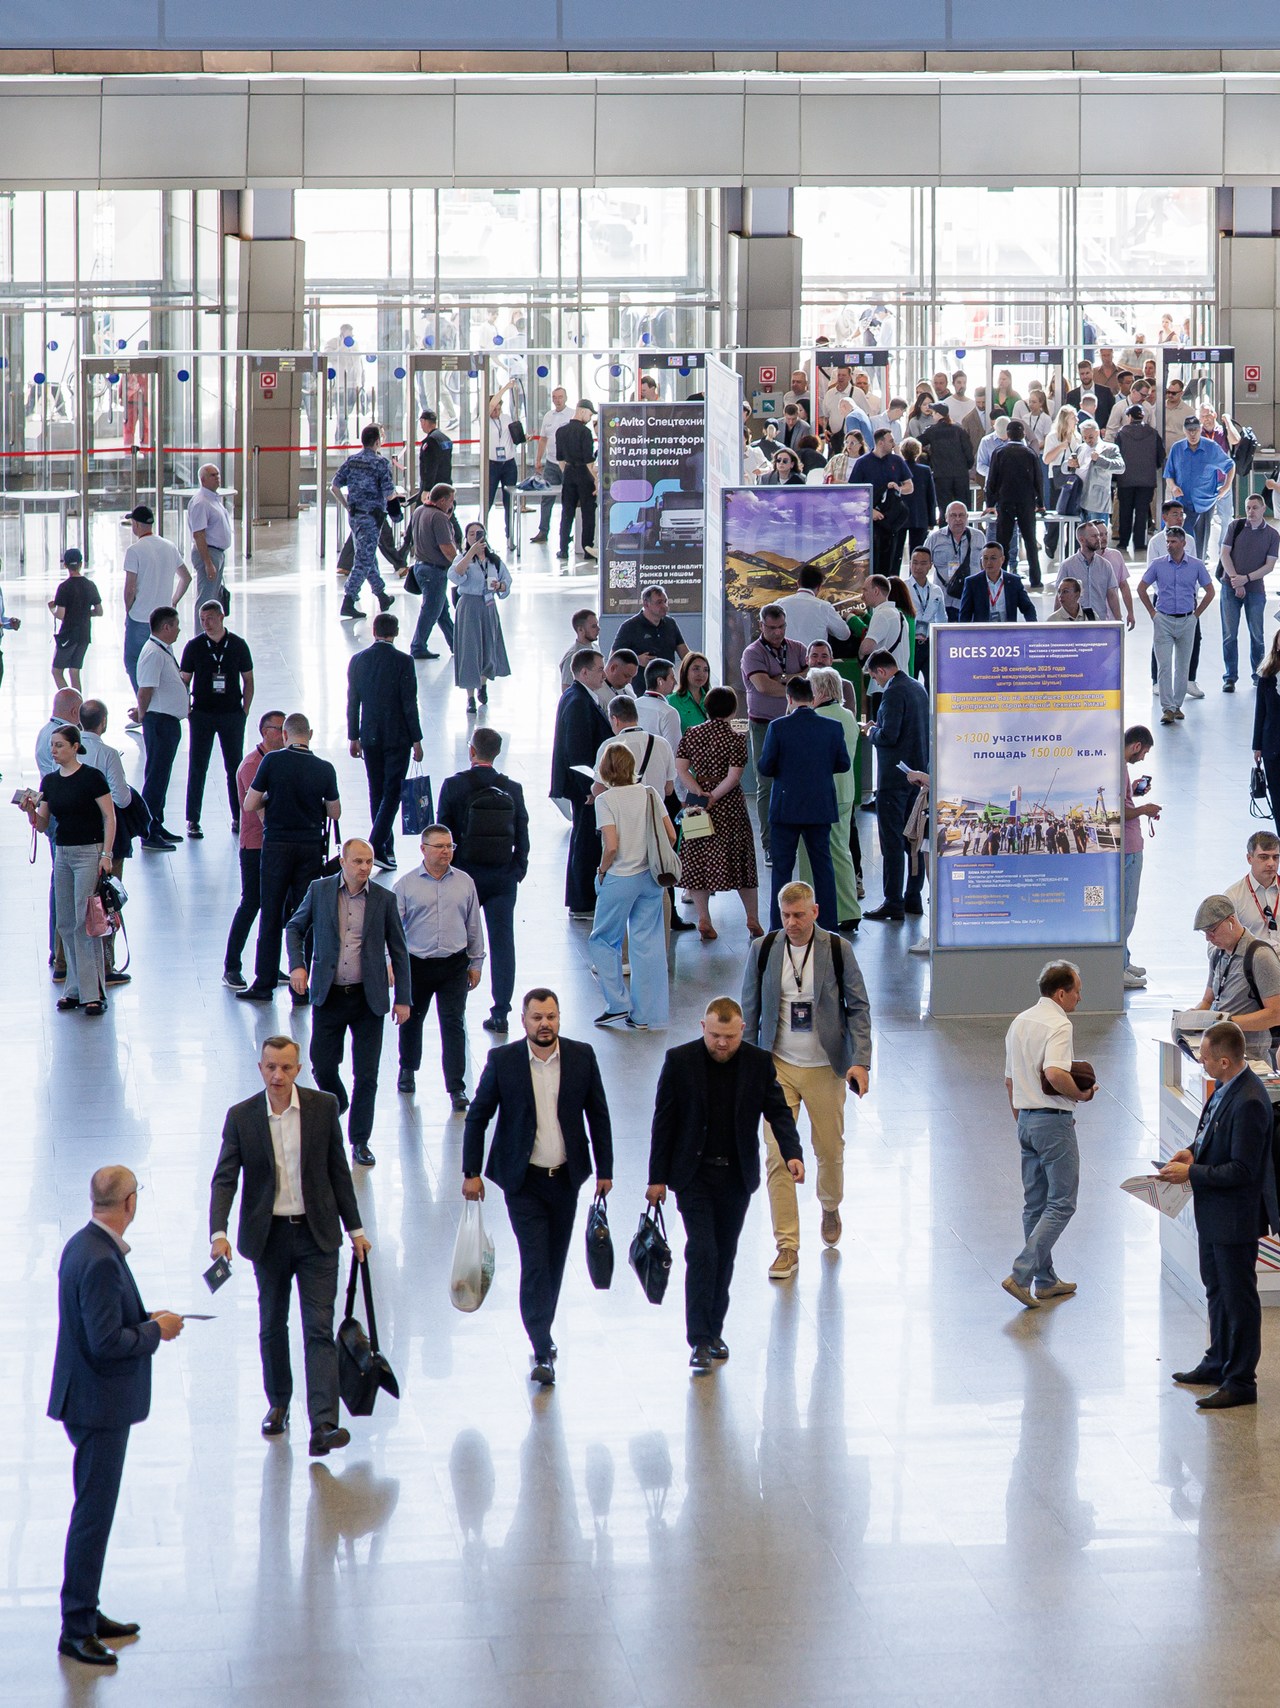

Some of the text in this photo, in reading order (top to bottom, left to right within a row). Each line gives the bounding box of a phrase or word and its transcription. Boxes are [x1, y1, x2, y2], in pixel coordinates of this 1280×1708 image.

[620, 417, 705, 427] Avito Спецтехни
[609, 447, 626, 455] №1
[650, 449, 691, 457] аренды
[609, 459, 679, 467] спецтехники
[950, 647, 987, 658] BICES
[990, 646, 1020, 658] 2025
[992, 733, 1062, 744] участников
[973, 747, 1107, 759] площадь 150 000 кв.м.
